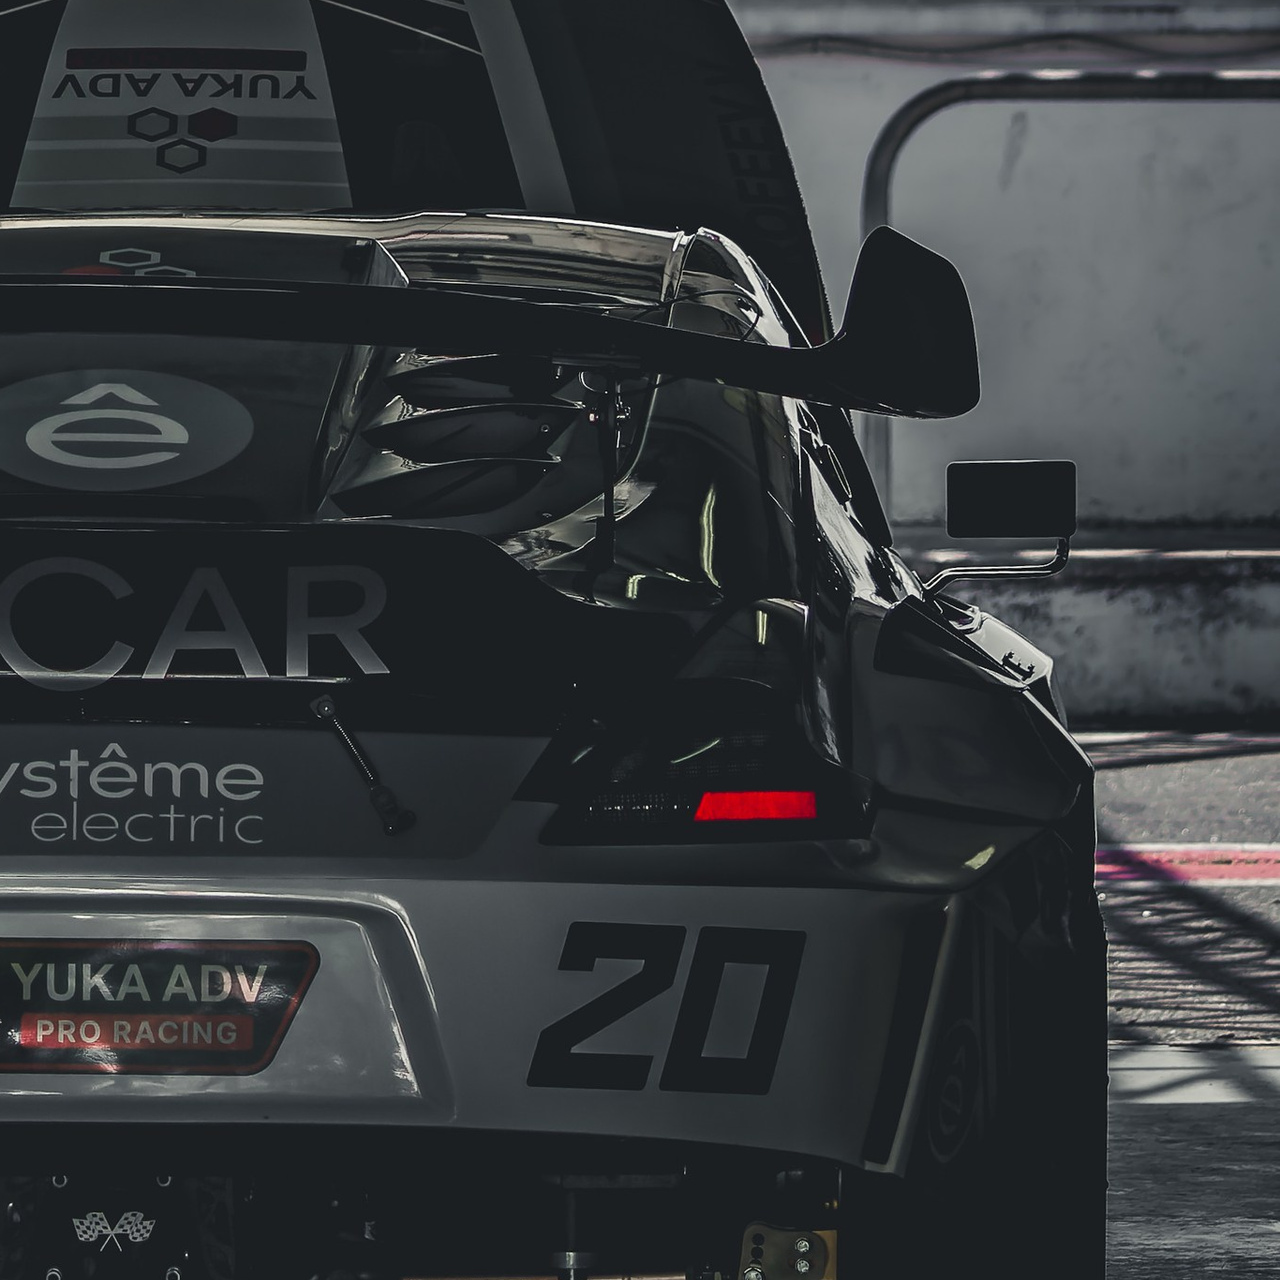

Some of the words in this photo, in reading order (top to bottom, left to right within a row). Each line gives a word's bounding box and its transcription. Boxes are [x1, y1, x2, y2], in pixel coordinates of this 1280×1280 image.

[51, 72, 162, 99] ADV
[172, 72, 318, 100] YUKA
[30, 801, 265, 845] electric
[11, 962, 154, 1003] YUKA
[161, 963, 269, 1005] ADV
[525, 920, 808, 1096] 20
[35, 1018, 102, 1045] PRO
[112, 1018, 239, 1046] RACING
